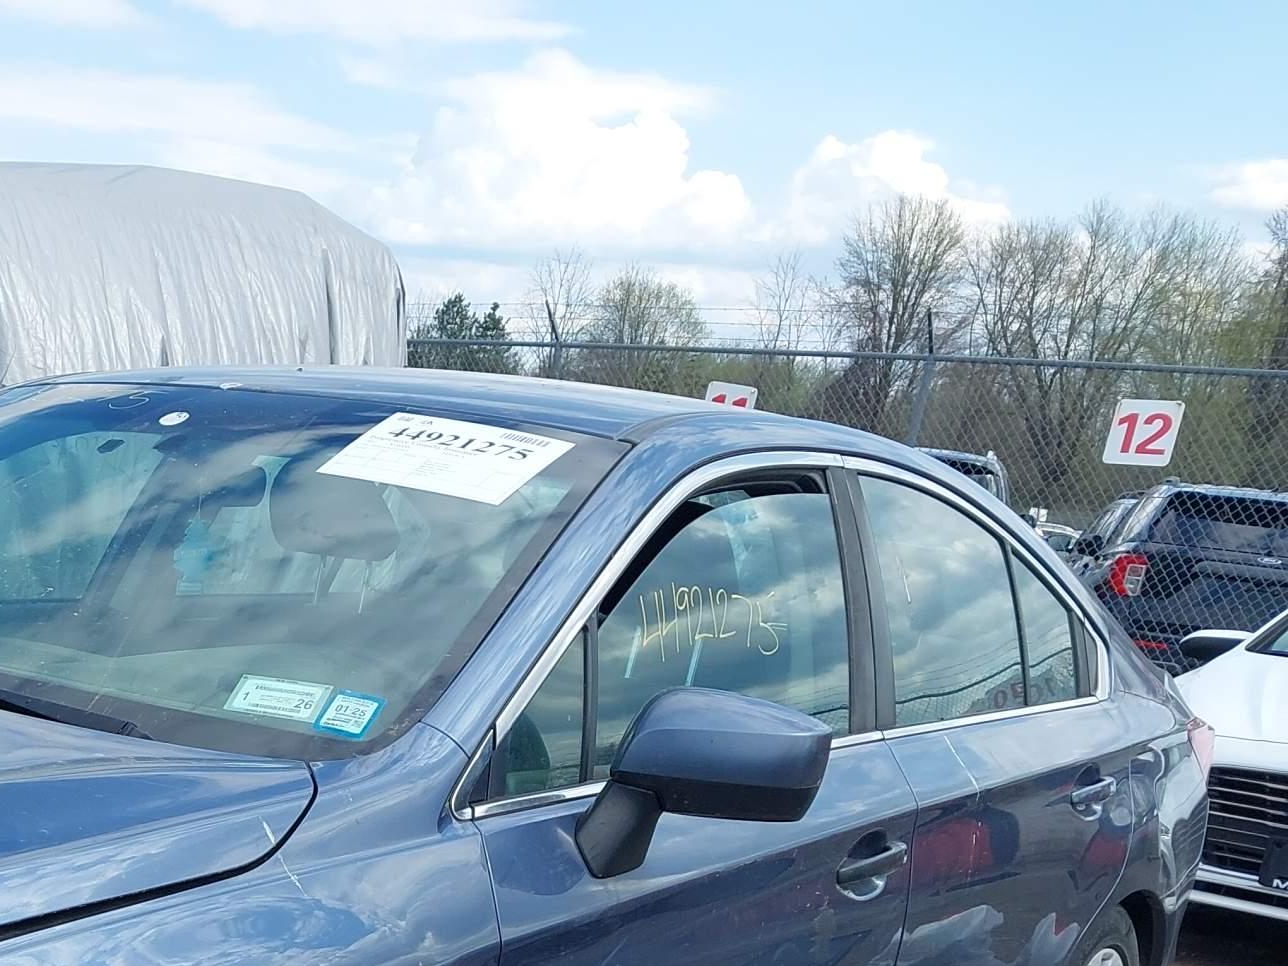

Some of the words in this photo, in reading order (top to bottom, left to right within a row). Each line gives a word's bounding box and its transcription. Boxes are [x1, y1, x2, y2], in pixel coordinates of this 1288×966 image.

[388, 427, 535, 461] 44921275
[1117, 412, 1173, 455] 12
[640, 581, 788, 662] 44921275
[294, 698, 313, 710] 26
